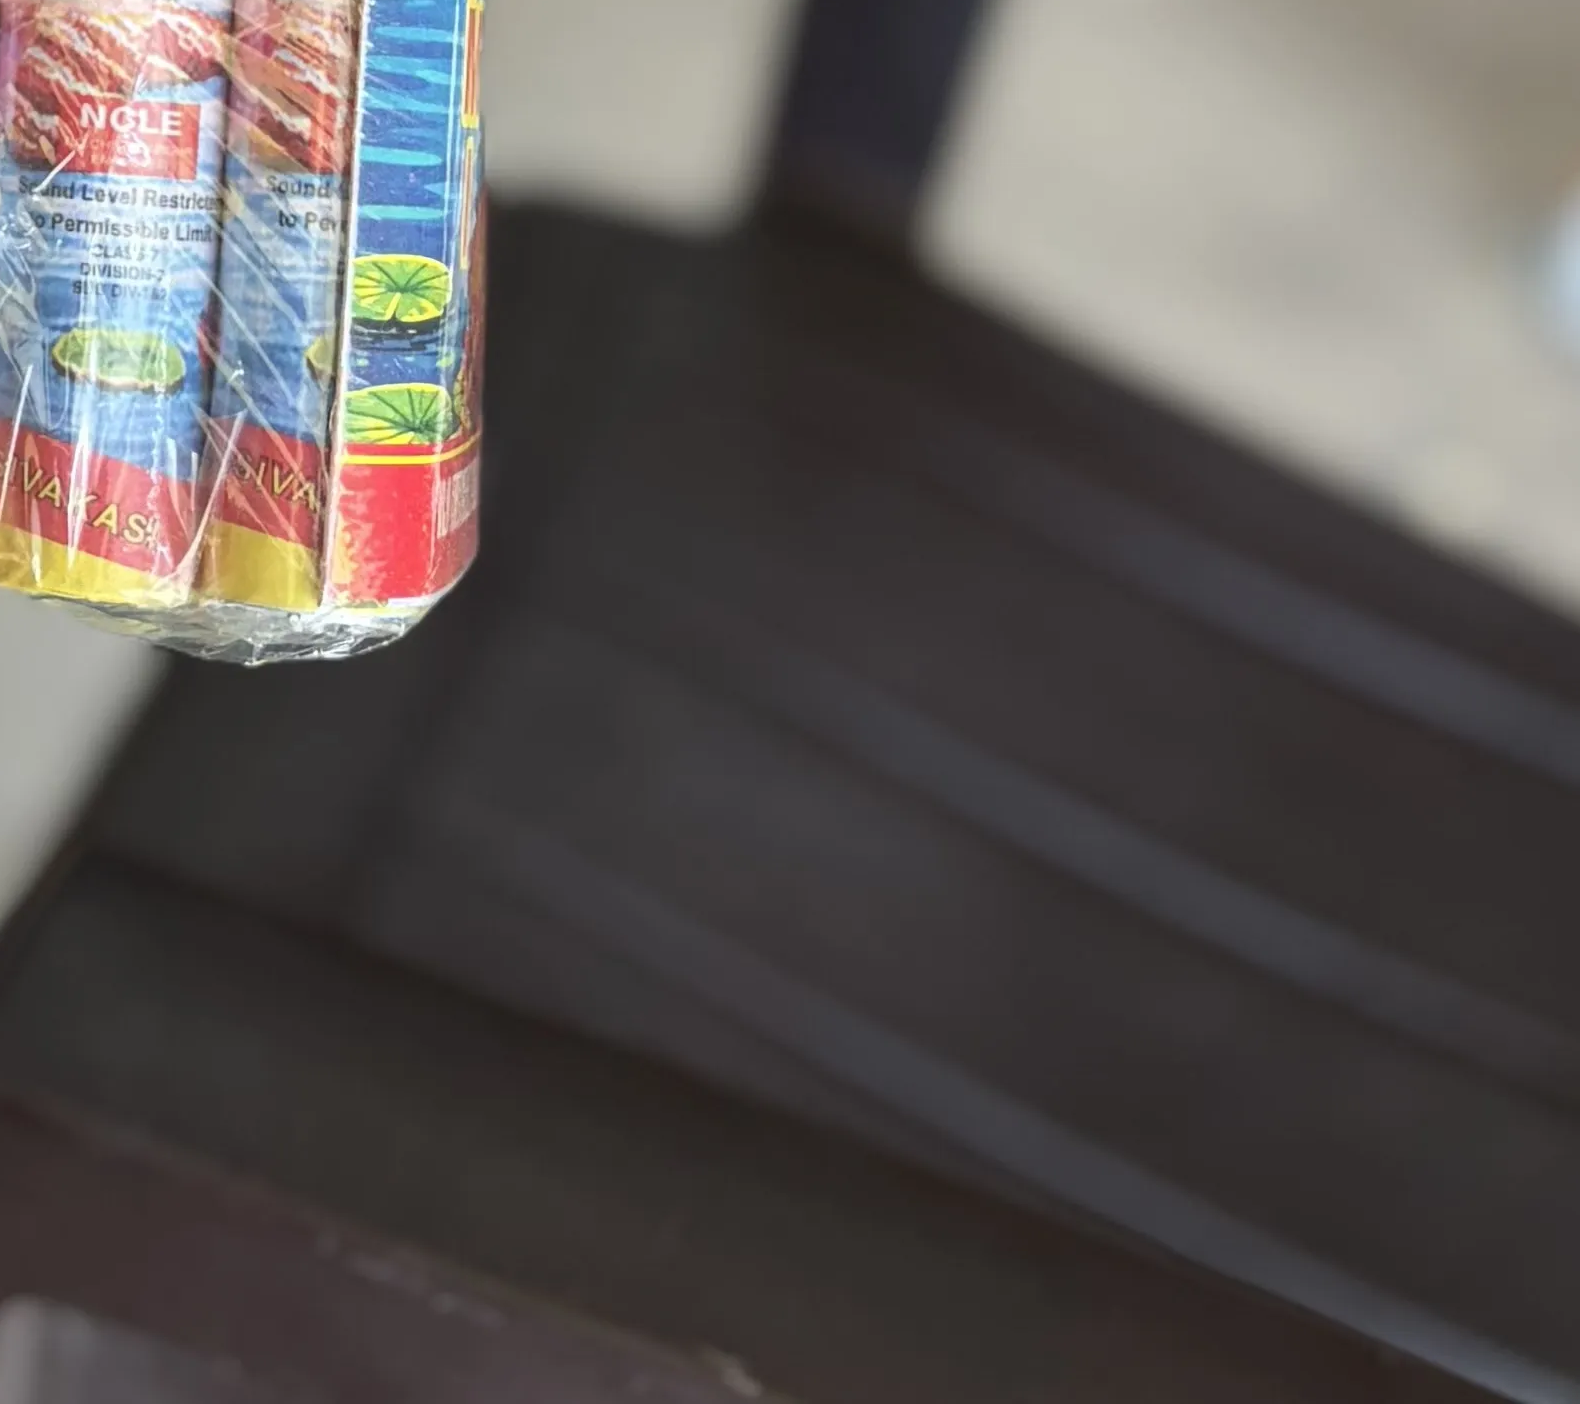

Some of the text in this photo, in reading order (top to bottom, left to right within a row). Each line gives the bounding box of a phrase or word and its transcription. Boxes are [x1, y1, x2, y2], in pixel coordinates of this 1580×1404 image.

[79, 102, 183, 137] NCLE
[81, 184, 138, 205] Level
[51, 213, 170, 240] Permissible
